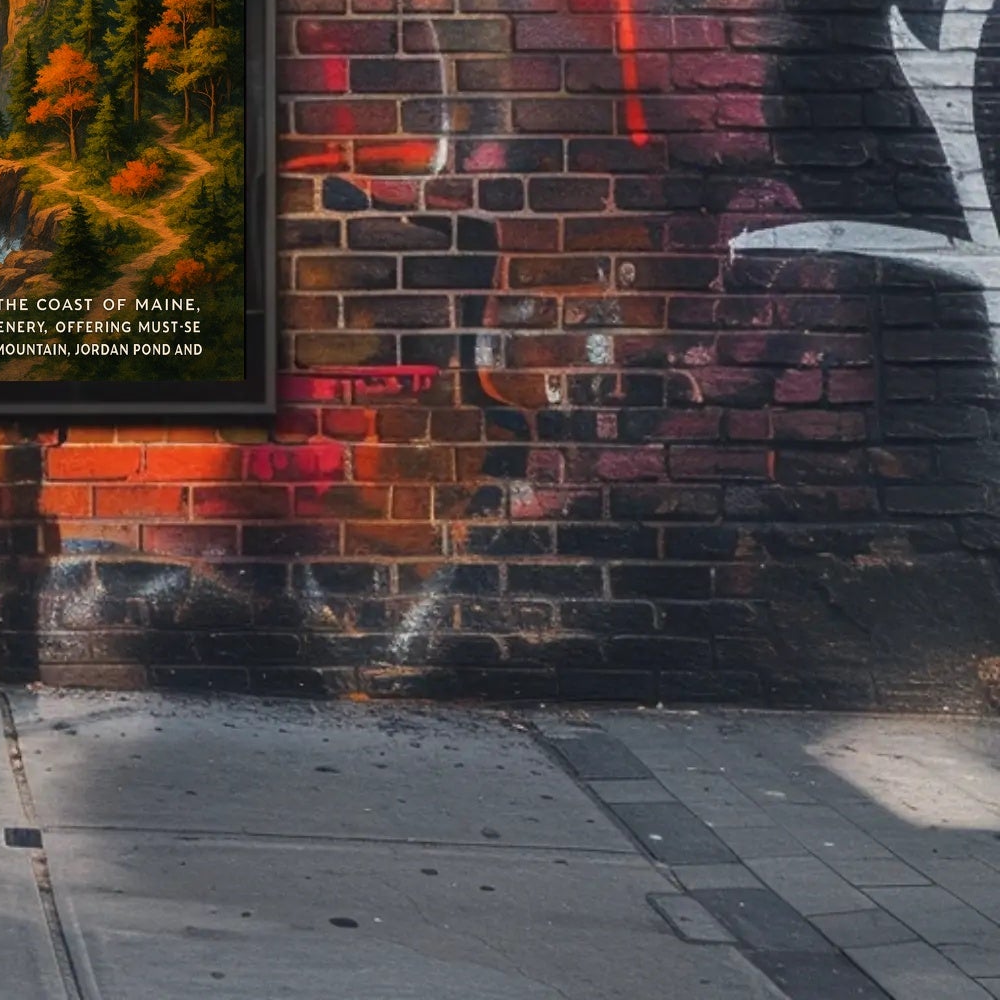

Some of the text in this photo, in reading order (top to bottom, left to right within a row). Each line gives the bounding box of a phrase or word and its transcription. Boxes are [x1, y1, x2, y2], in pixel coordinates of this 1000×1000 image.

[36, 298, 93, 311] COAST
[103, 298, 127, 311] OF
[135, 298, 201, 313] MAINE,
[55, 321, 132, 333] OFFERING
[138, 321, 201, 333] MUST-SE
[74, 343, 129, 356] JORDAN
[133, 343, 171, 356] POND
[174, 343, 203, 356] AND
